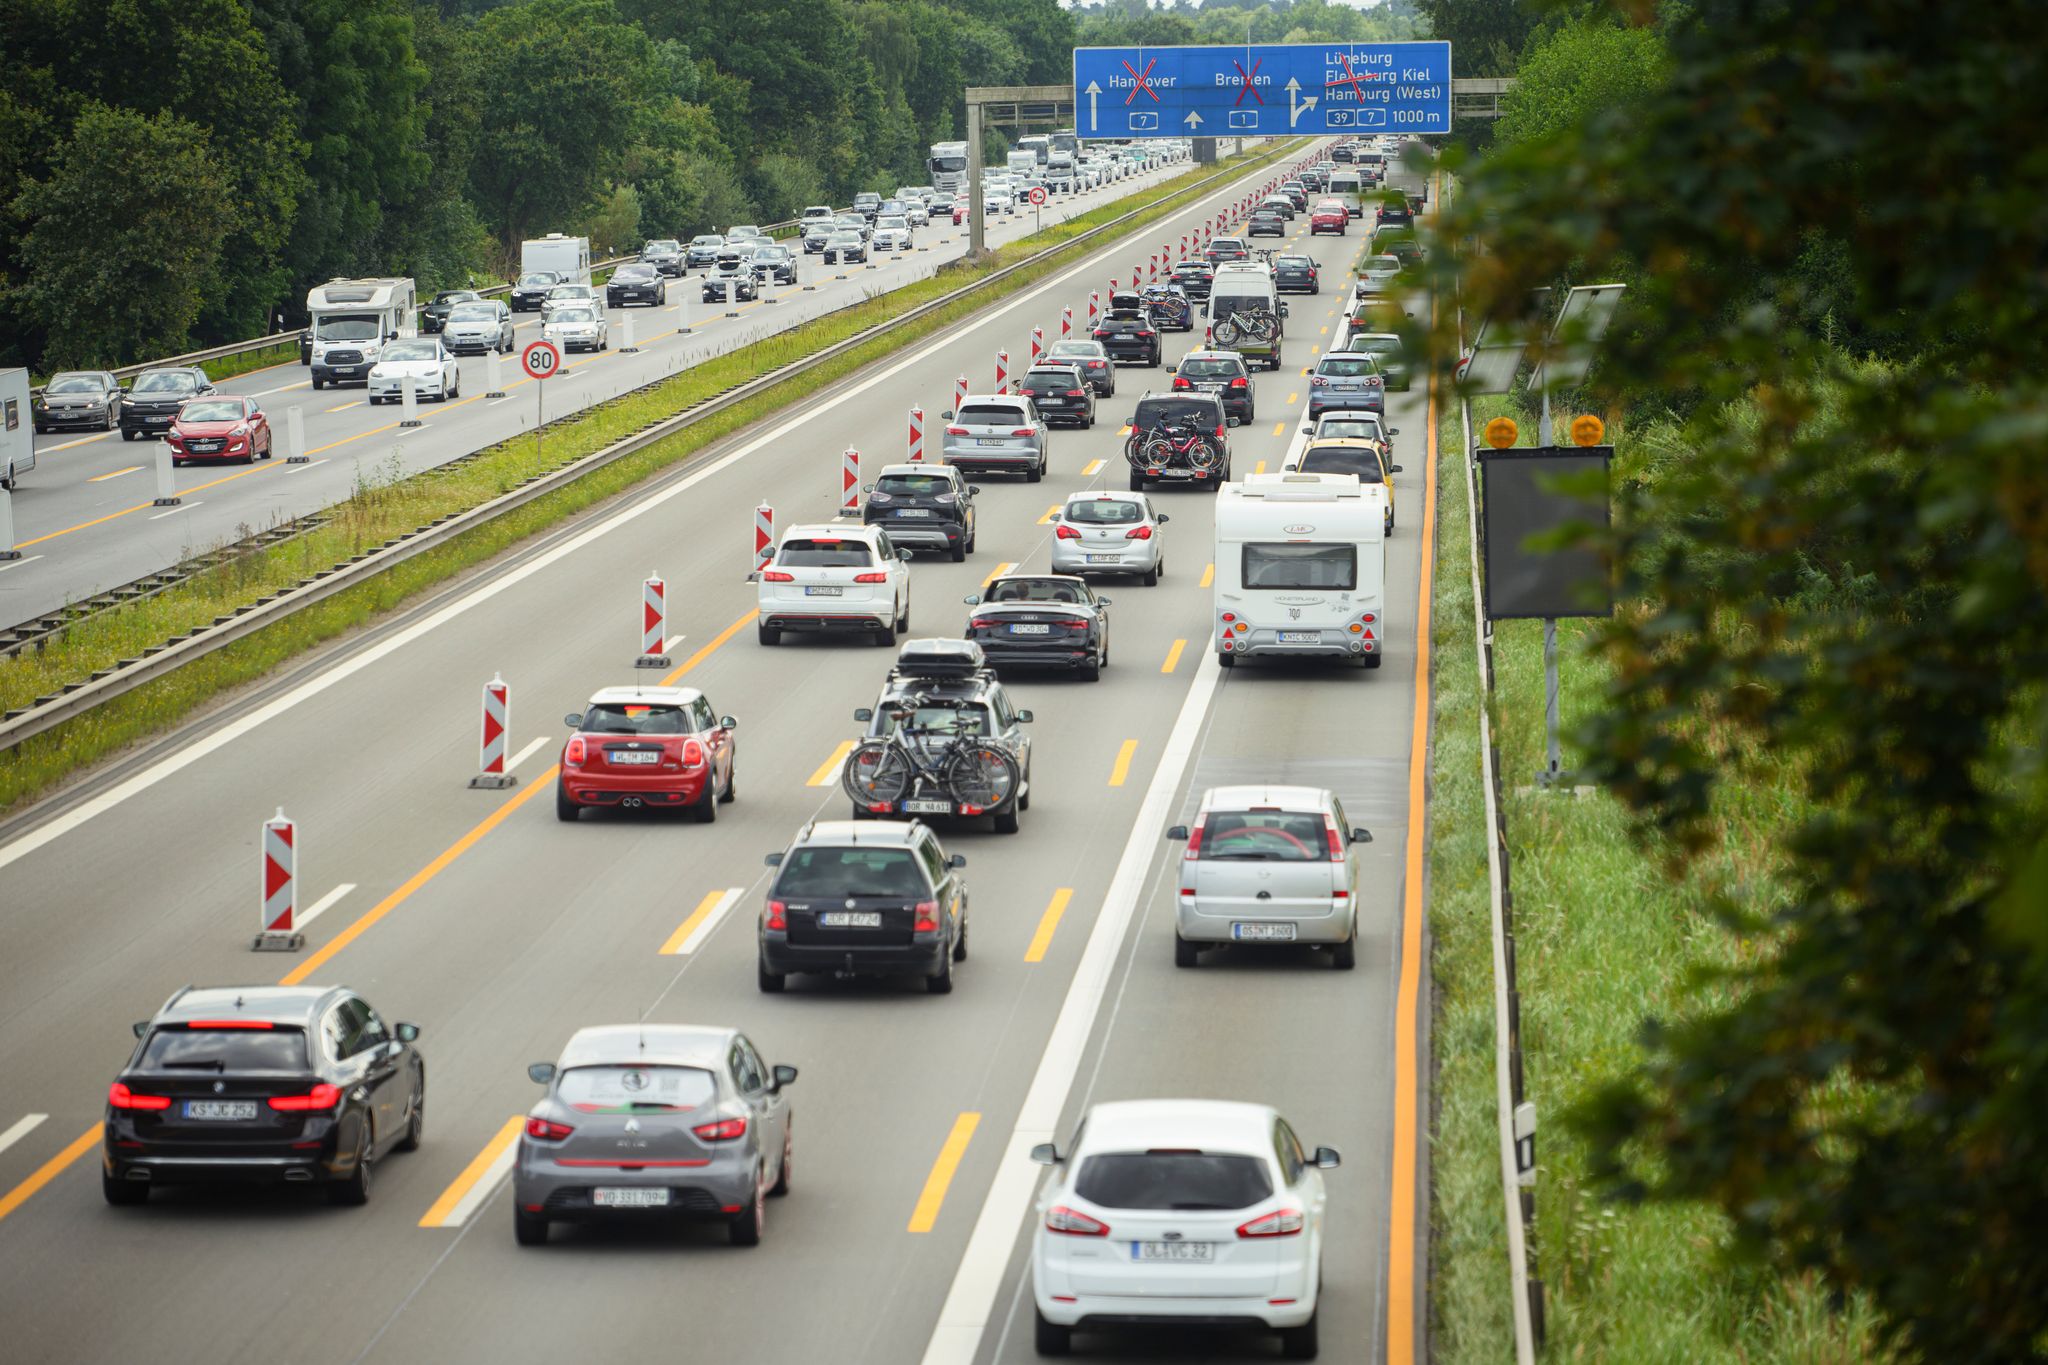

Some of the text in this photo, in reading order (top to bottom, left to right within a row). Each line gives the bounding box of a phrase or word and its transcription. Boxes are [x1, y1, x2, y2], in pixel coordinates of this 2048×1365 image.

[1325, 51, 1393, 67] Lüneburg
[1109, 74, 1177, 88] Hanover
[1402, 67, 1431, 82] Kiel
[1396, 85, 1442, 100] (West)
[1140, 115, 1148, 127] 7
[1334, 112, 1348, 123] 39
[1367, 112, 1375, 123] 7
[1392, 110, 1440, 123] 1000 m
[530, 351, 552, 369] 80
